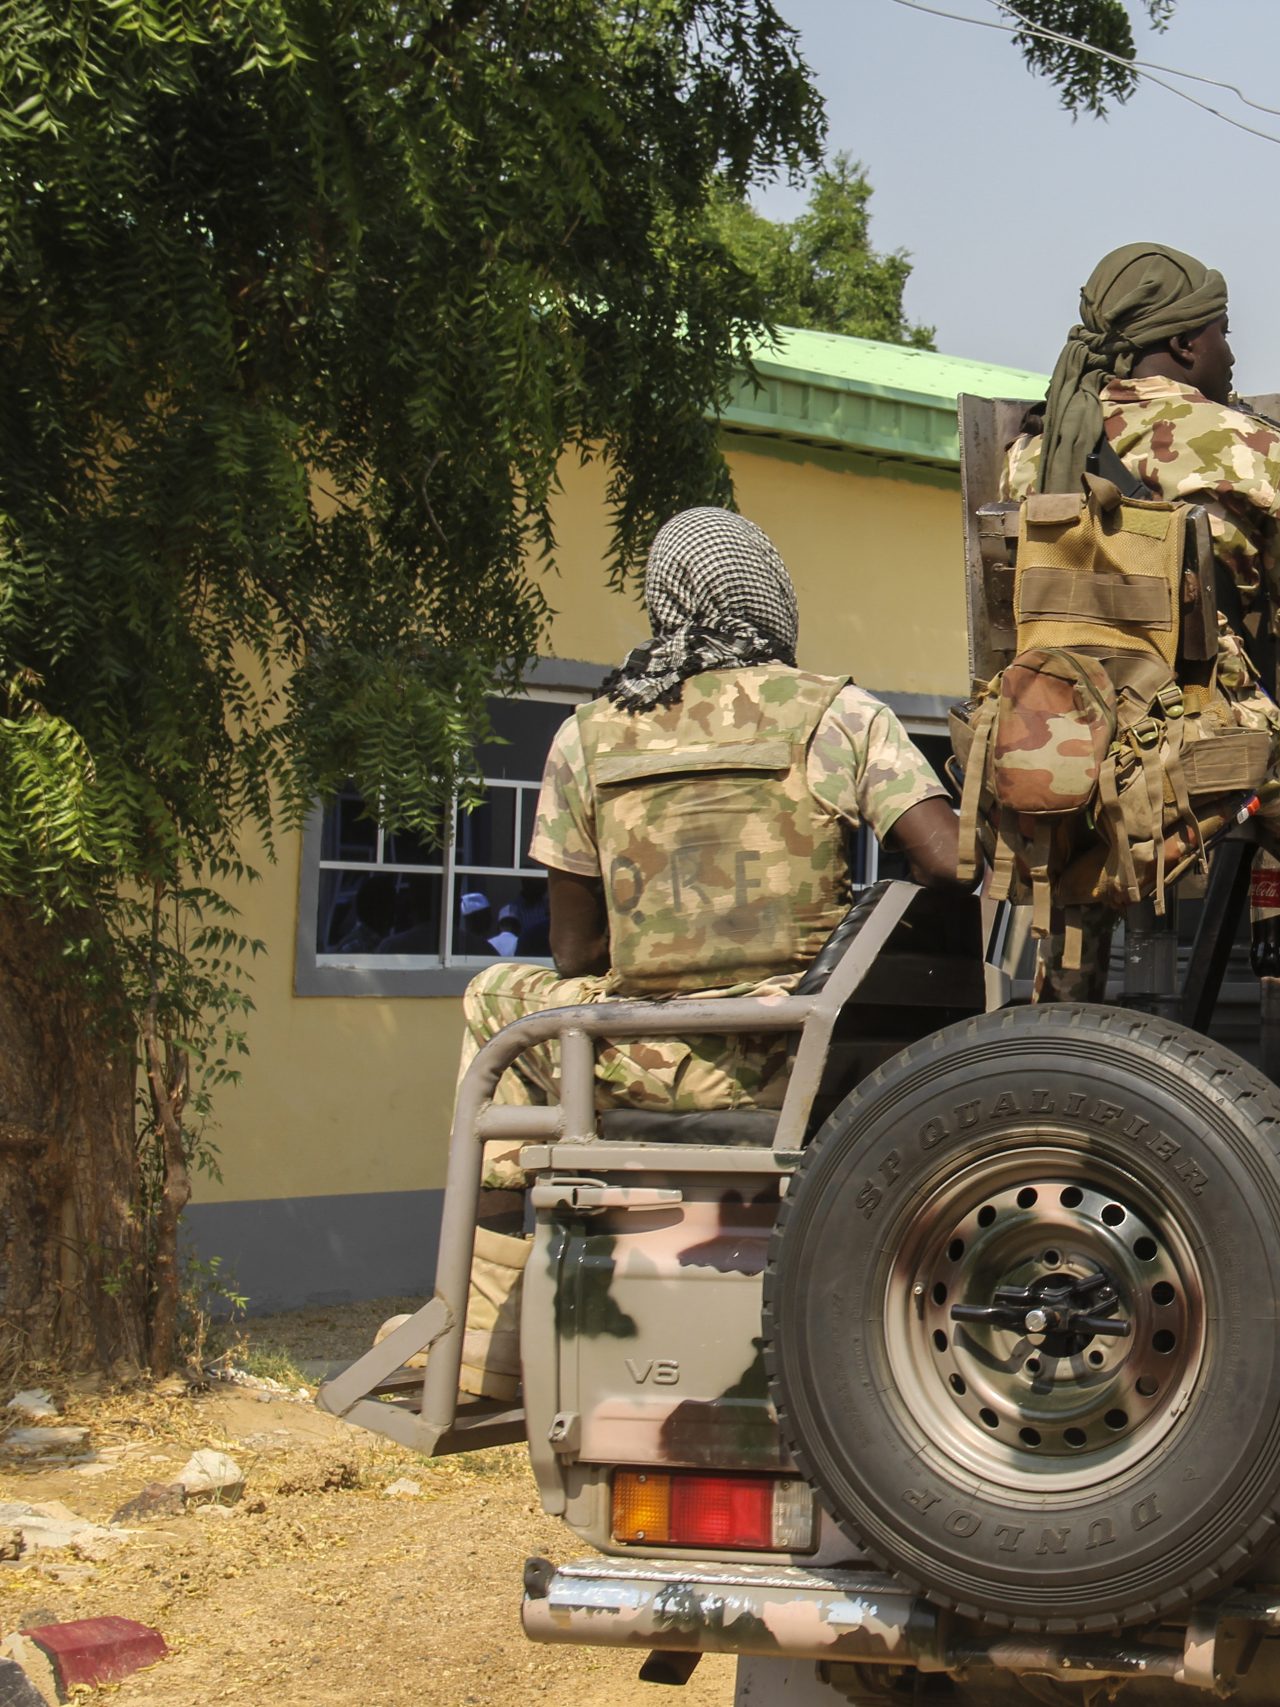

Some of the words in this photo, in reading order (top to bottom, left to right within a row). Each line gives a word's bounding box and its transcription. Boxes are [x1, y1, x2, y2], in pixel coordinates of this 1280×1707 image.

[855, 1148, 903, 1220] SP
[918, 1090, 1209, 1196] QUALIFIER
[901, 1487, 1163, 1555] DUNLOP
